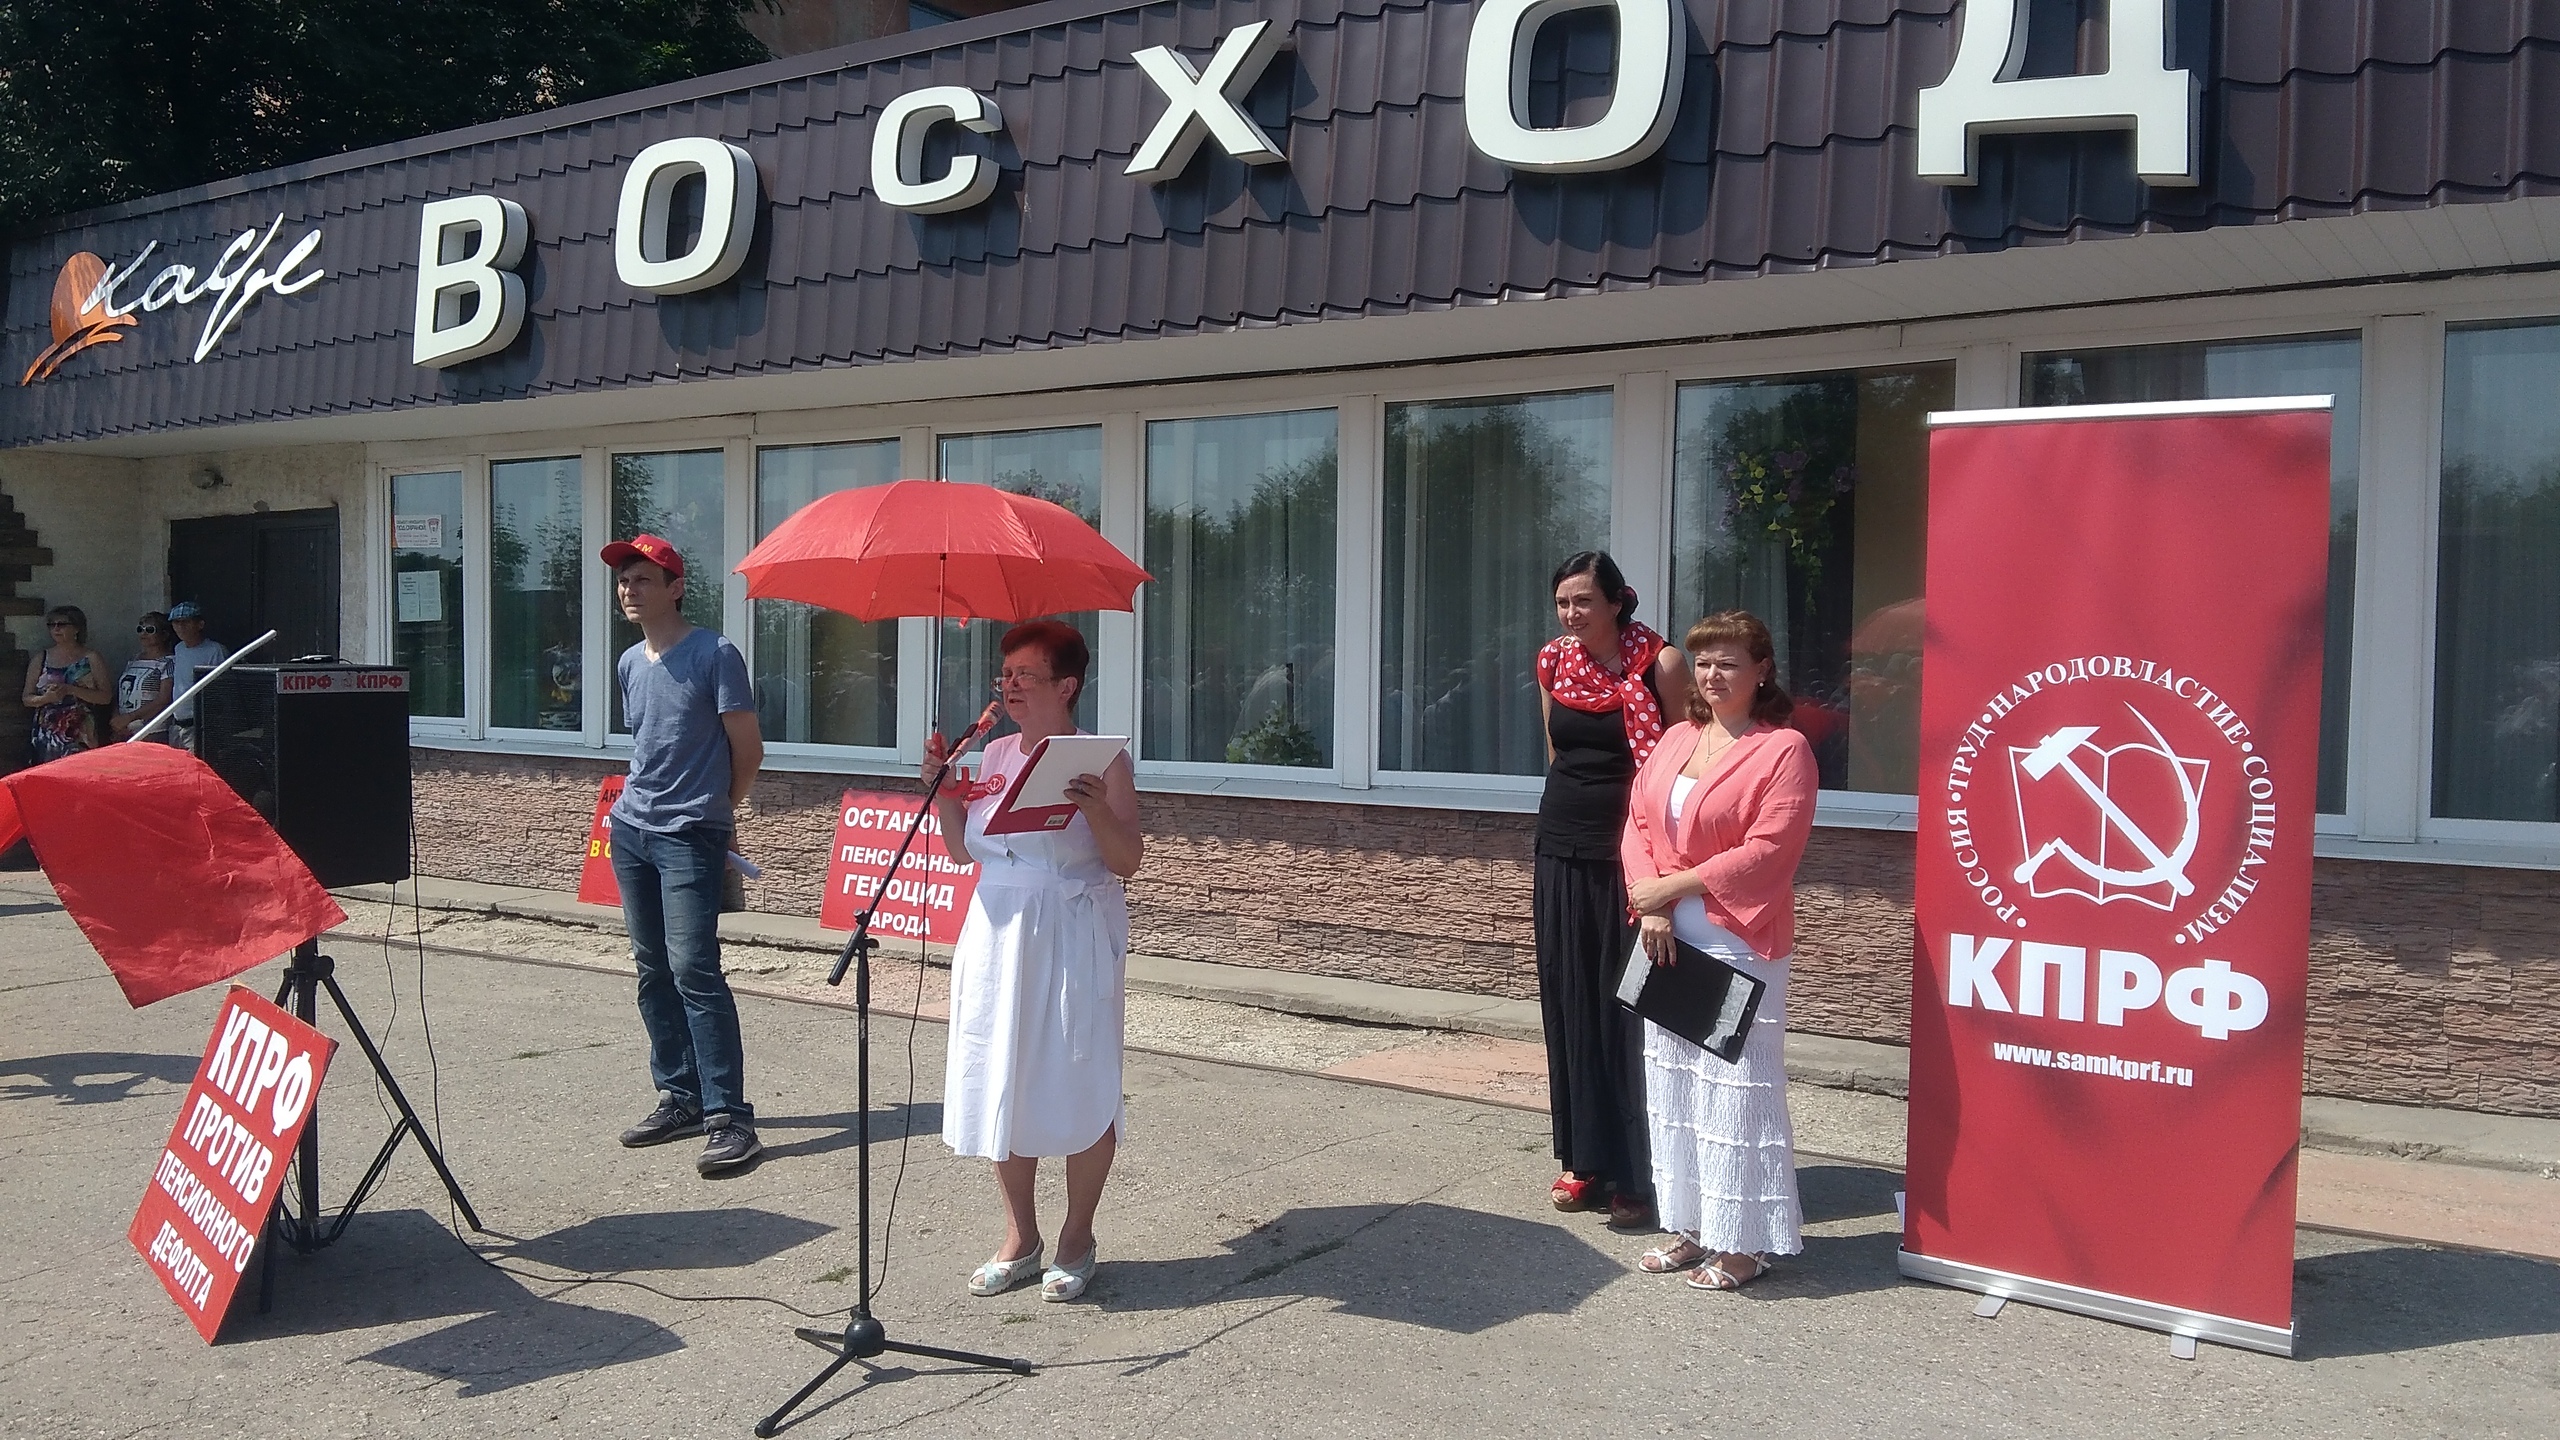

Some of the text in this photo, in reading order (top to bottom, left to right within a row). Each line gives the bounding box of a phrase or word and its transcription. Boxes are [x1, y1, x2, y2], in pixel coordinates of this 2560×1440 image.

[413, 0, 2200, 369] ВОСХОД
[81, 212, 324, 363] Кафе
[282, 674, 403, 690] КПРФ КПРФ
[1986, 655, 2251, 745] НАРОДОВЛАСТИЕ
[1947, 720, 1996, 791] ТРУД
[842, 873, 955, 911] ГЕНОЦИД
[1947, 807, 2020, 924] РОССИЯ
[2183, 755, 2276, 944] СОЦИАЛИЗМ
[863, 909, 931, 937] АРОДА
[1948, 933, 2269, 1040] КПРФ
[206, 1003, 313, 1137] КПРФ
[1993, 1042, 2194, 1087] www.samkprf.ru
[182, 1091, 273, 1205] ПРОТИВ
[155, 1148, 256, 1274] ПЕНСИОННОГО
[149, 1218, 215, 1313] ДЕФОЛТА
